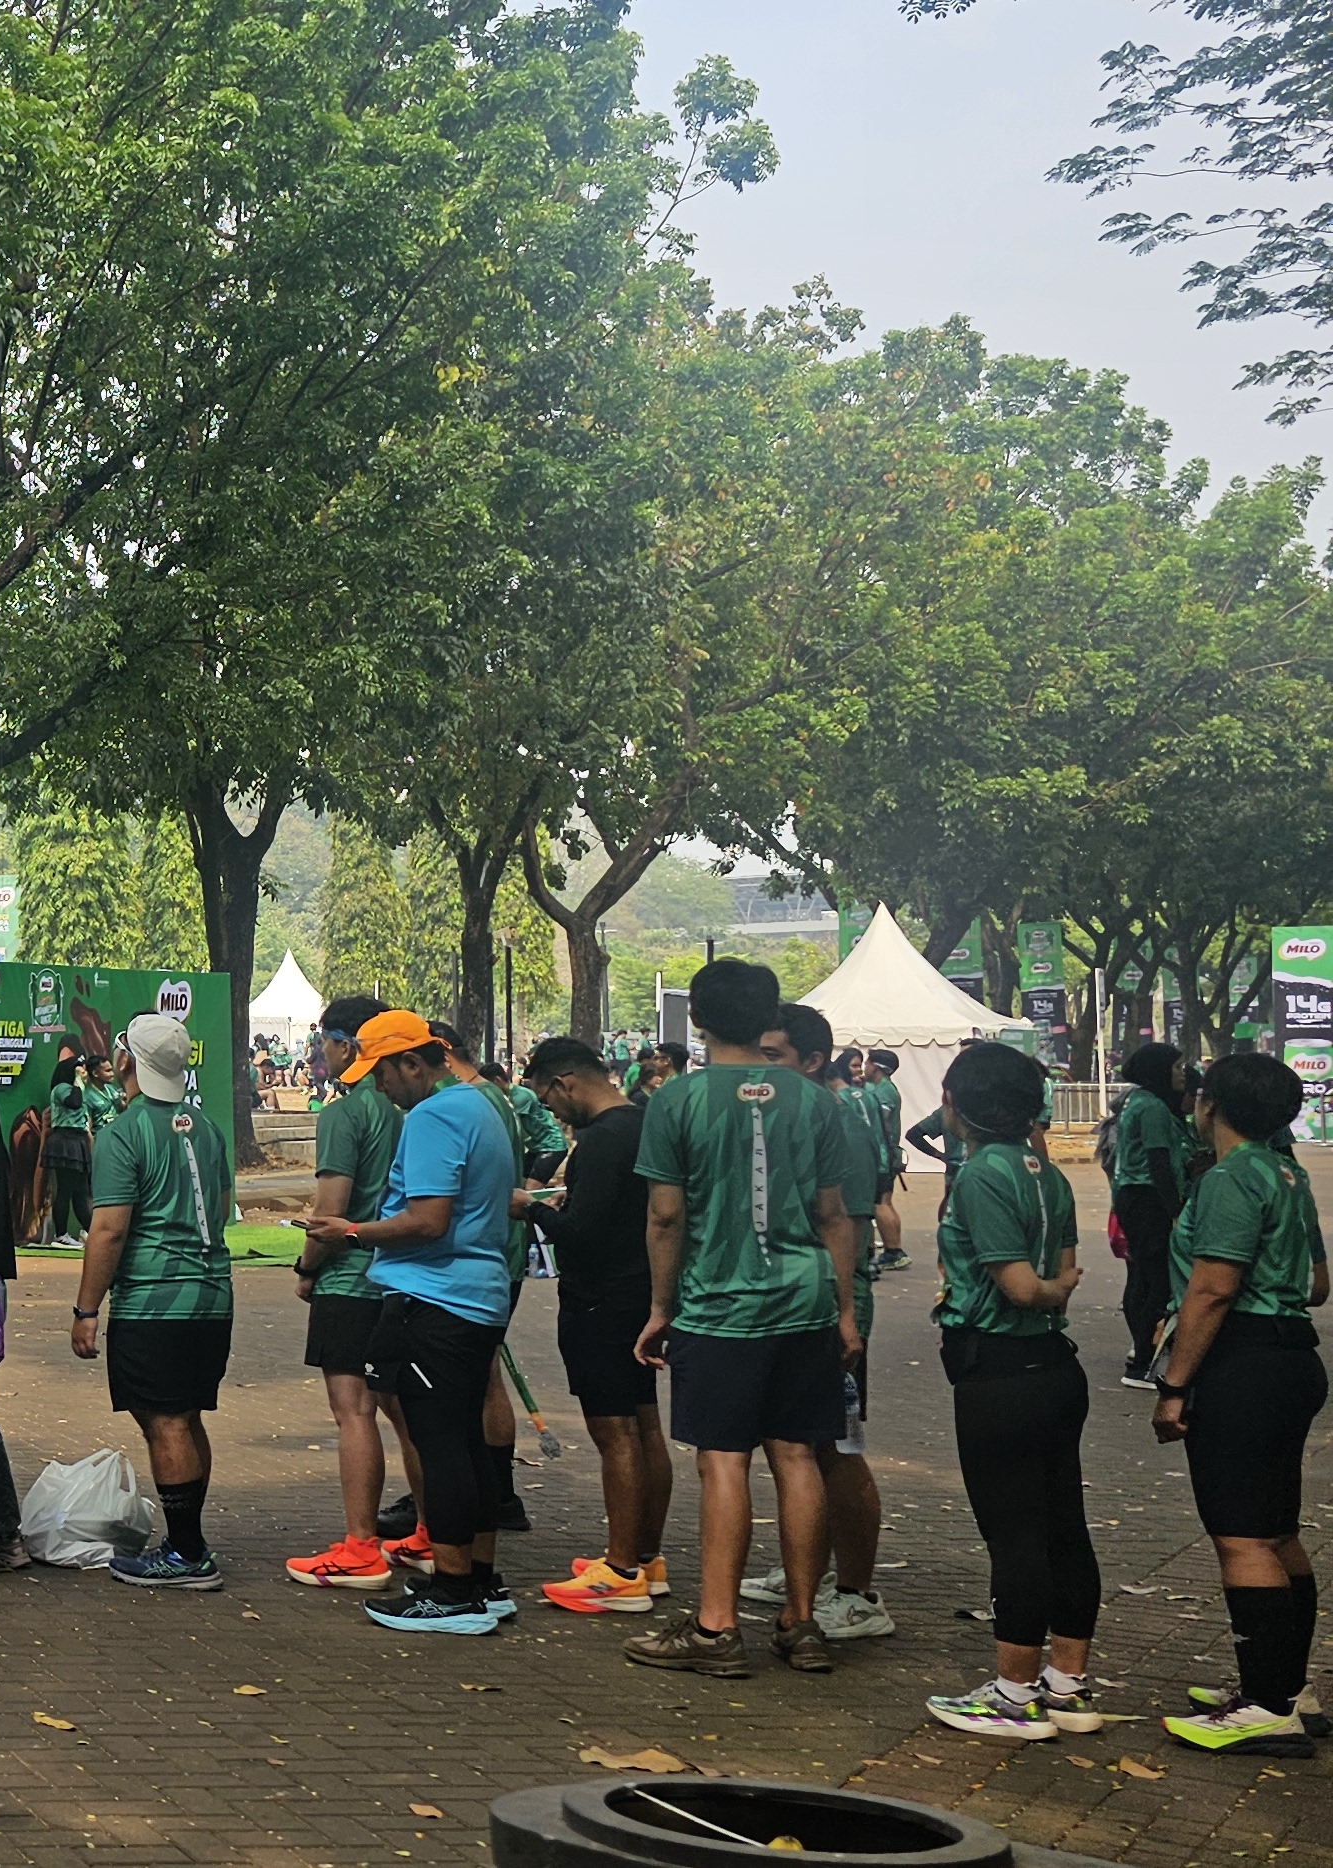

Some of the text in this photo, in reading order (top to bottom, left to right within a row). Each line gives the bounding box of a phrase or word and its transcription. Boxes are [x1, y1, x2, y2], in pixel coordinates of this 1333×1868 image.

[1286, 945, 1320, 954] MILO
[160, 992, 188, 1012] MILO
[1285, 1012, 1332, 1020] PROTEIN
[1294, 1060, 1326, 1070] MILO
[1302, 1083, 1326, 1094] RO
